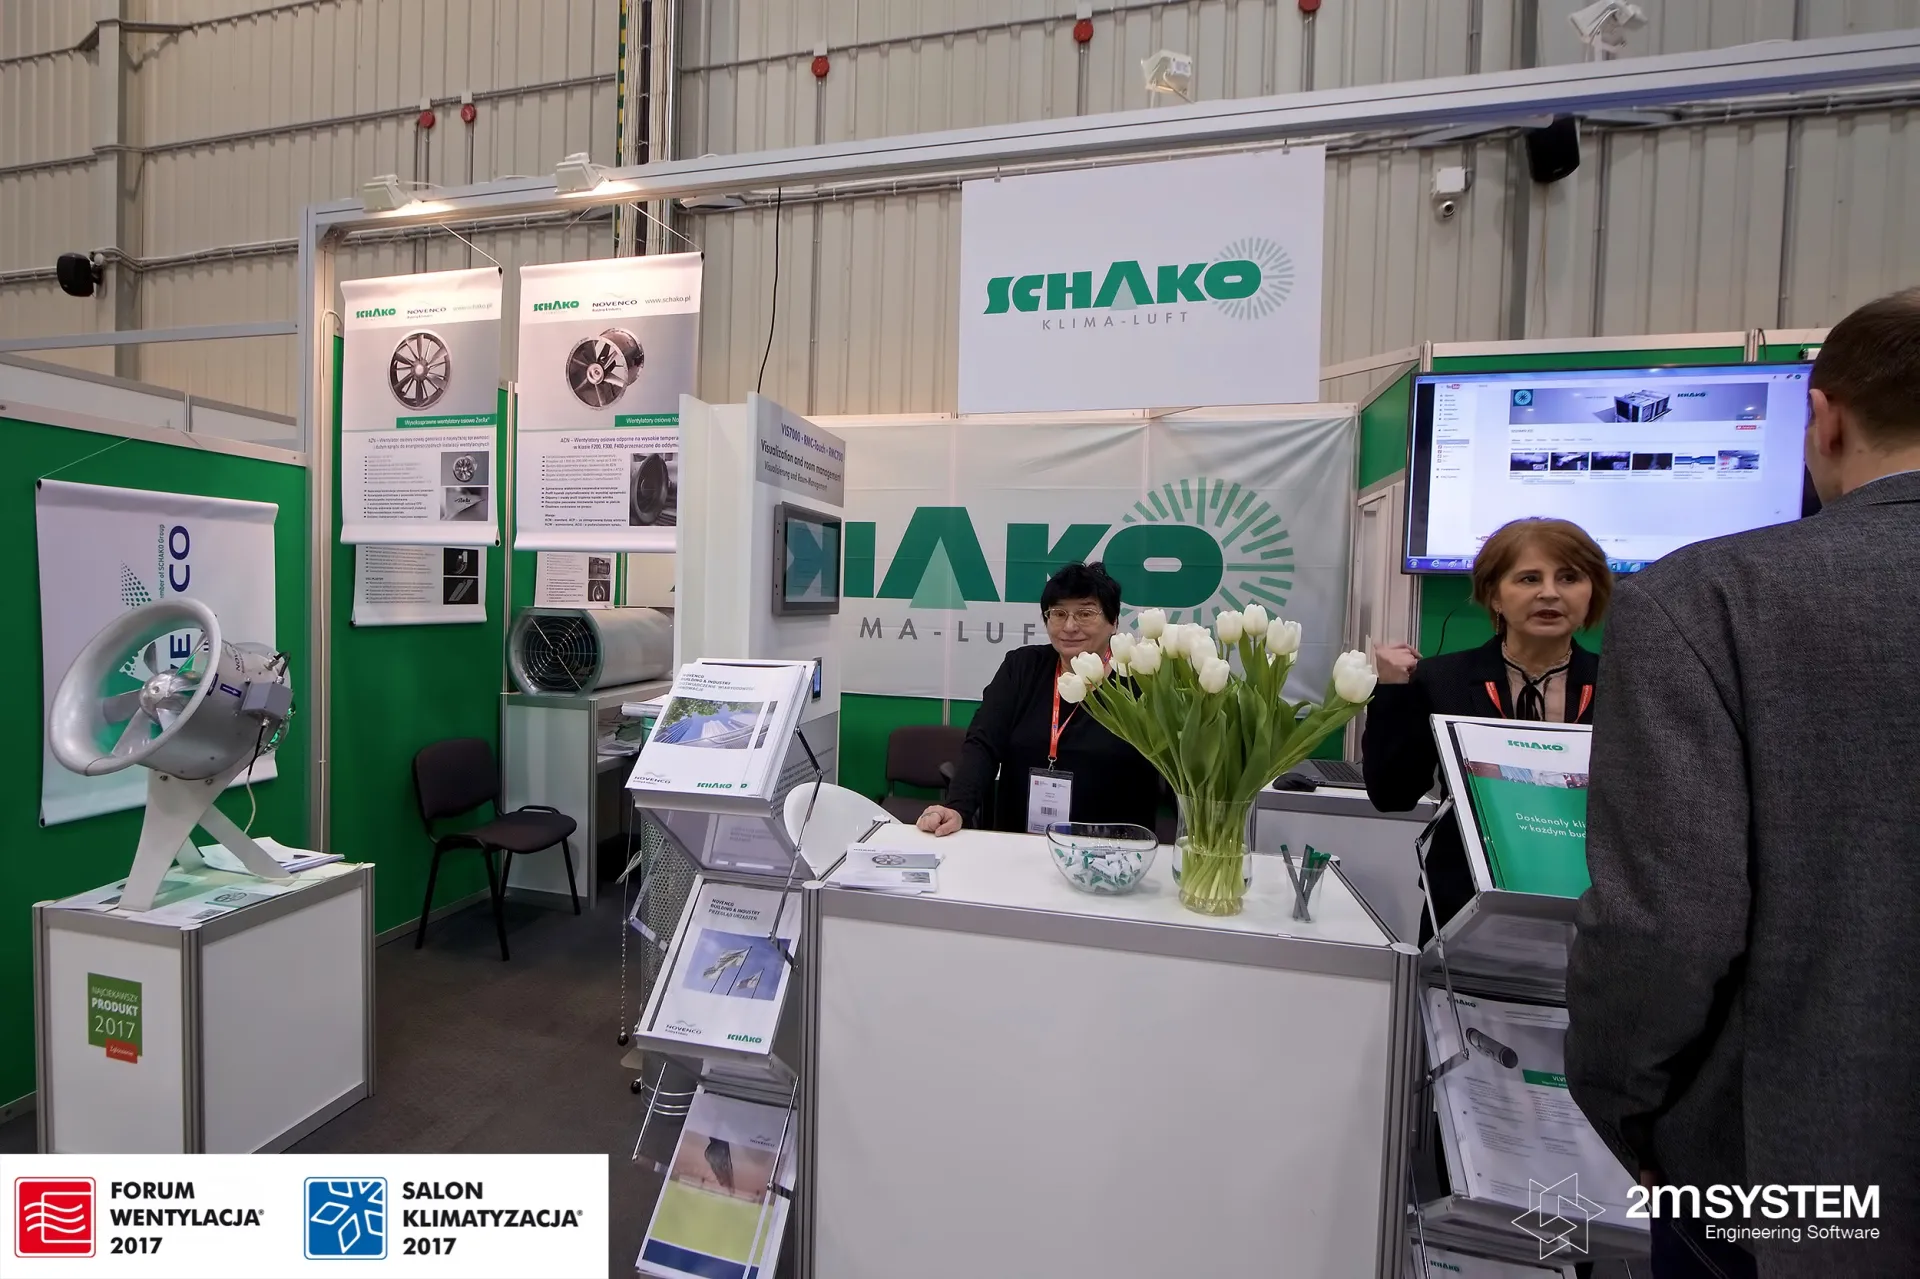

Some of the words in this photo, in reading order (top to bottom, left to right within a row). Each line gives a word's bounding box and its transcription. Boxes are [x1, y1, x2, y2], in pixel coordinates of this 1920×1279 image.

[983, 259, 1262, 314] SCHAKO
[592, 299, 638, 308] NOVENCO
[645, 295, 692, 305] www.schako.pl
[407, 306, 447, 315] NOVENCO
[533, 300, 580, 312] SCHAKO
[356, 308, 396, 318] SCHAKO
[1042, 311, 1188, 330] KLIMA-LUFT
[760, 439, 793, 463] Visualization
[794, 456, 803, 467] and
[804, 460, 816, 472] room
[1507, 739, 1564, 751] SCHAKO
[634, 776, 671, 784] NOVENCO
[91, 997, 139, 1016] PRODUKT
[95, 1015, 136, 1039] 2017
[666, 1024, 702, 1035] NOVENCO
[727, 1033, 762, 1044] SCHAKO
